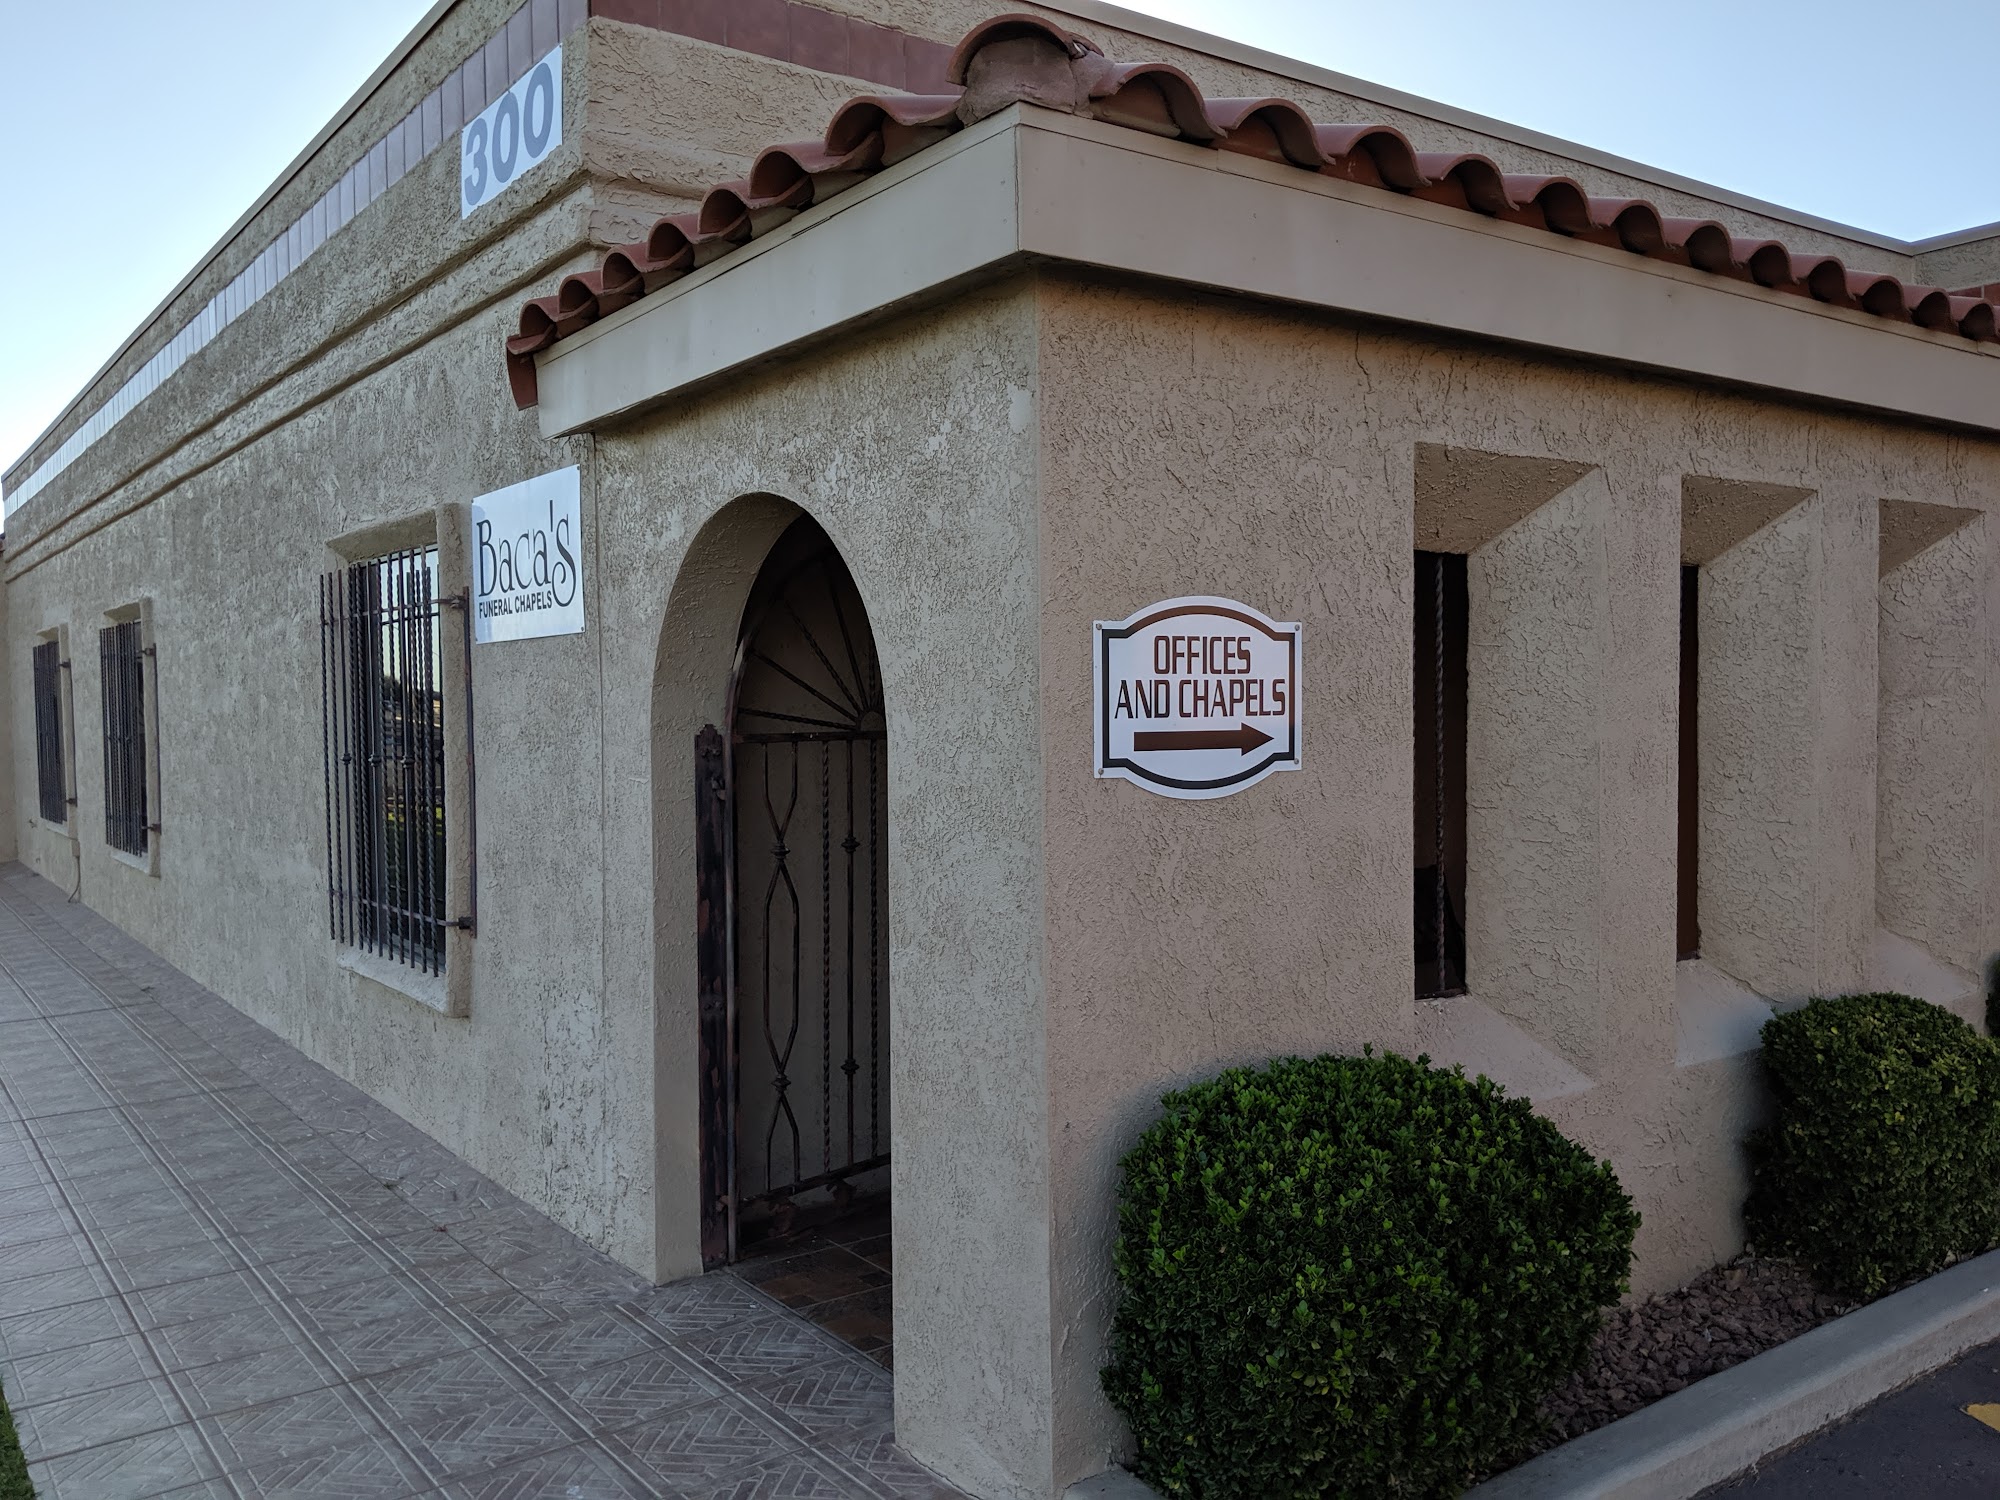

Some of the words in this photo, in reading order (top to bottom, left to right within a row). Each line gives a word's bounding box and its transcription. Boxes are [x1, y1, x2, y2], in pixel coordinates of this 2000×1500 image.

[464, 62, 554, 206] 300
[476, 499, 577, 608] Baca's
[478, 595, 513, 619] FUNERAL
[514, 590, 553, 614] CHAPELS
[1153, 635, 1251, 675] OFFICES
[1114, 679, 1171, 719] AND
[1178, 678, 1286, 718] CHAPELS
